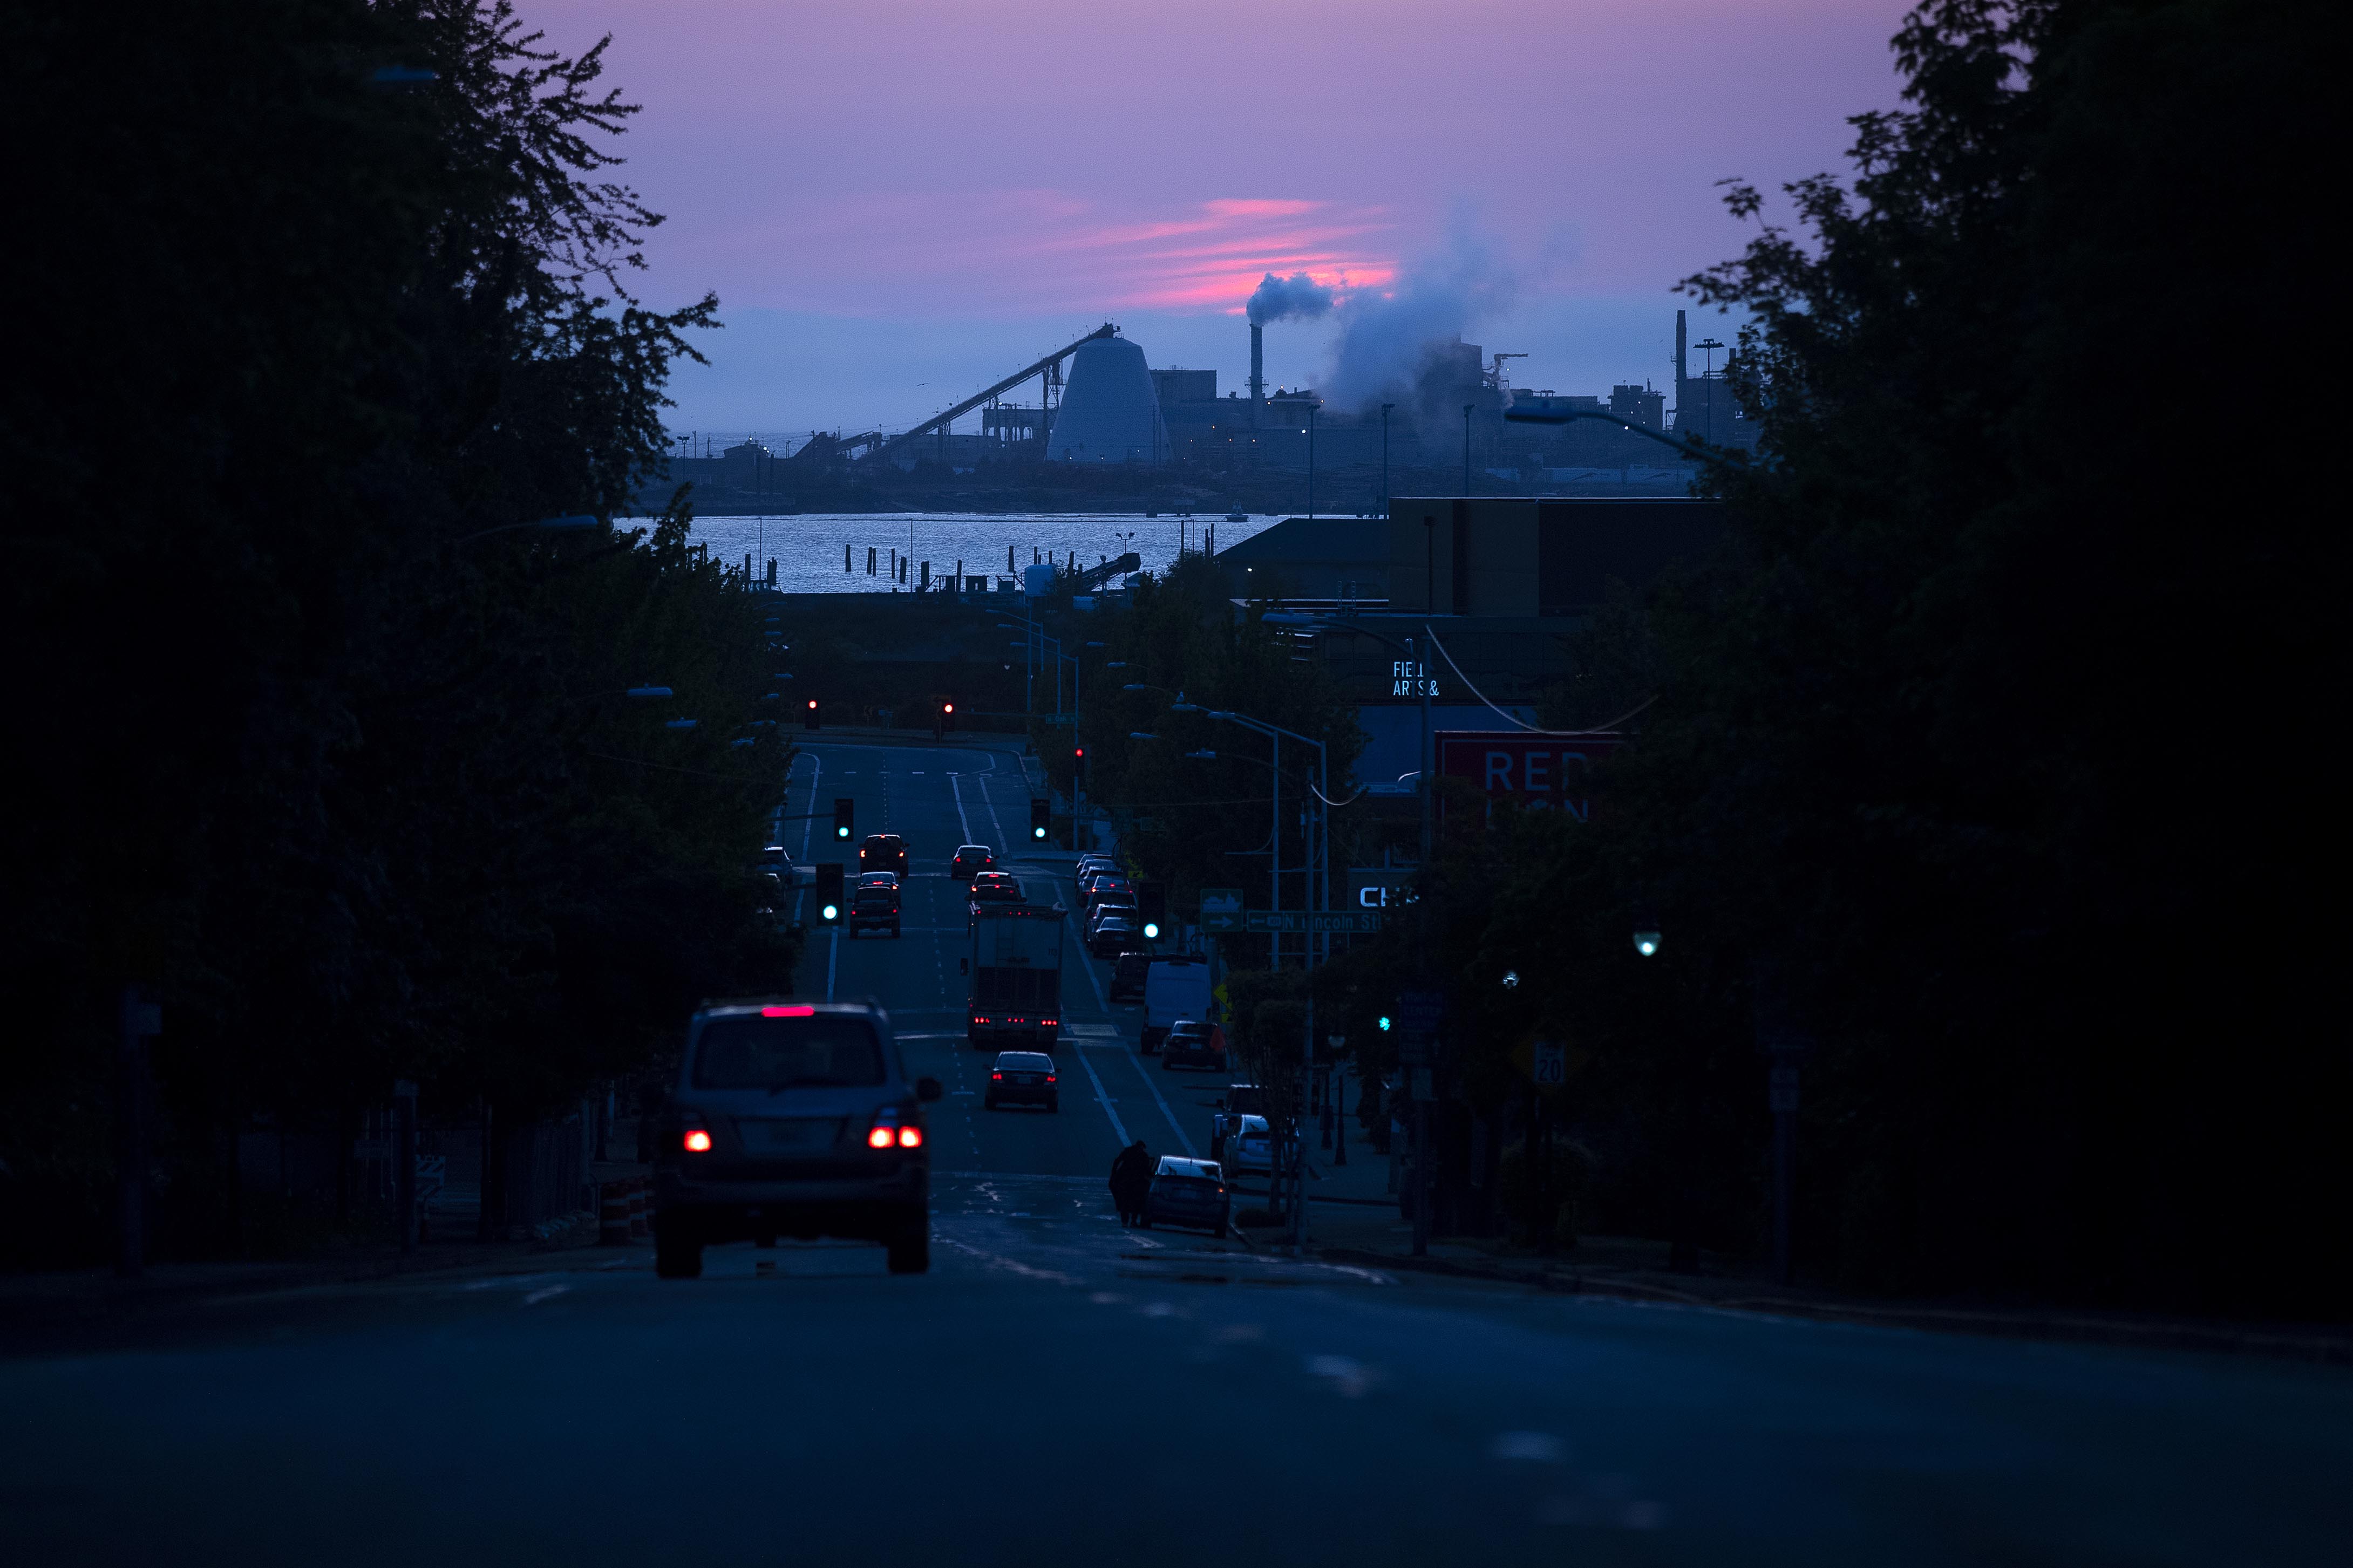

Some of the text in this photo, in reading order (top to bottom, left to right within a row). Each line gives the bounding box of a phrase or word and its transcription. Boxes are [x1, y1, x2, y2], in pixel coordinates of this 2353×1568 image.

[1393, 680, 1439, 696] ARS &
[1485, 751, 1591, 791] RED
[1485, 799, 1588, 830] LN
[1285, 914, 1294, 929] N
[1302, 915, 1353, 929] Lncoln
[1360, 914, 1377, 930] St
[1538, 1059, 1561, 1082] 20
